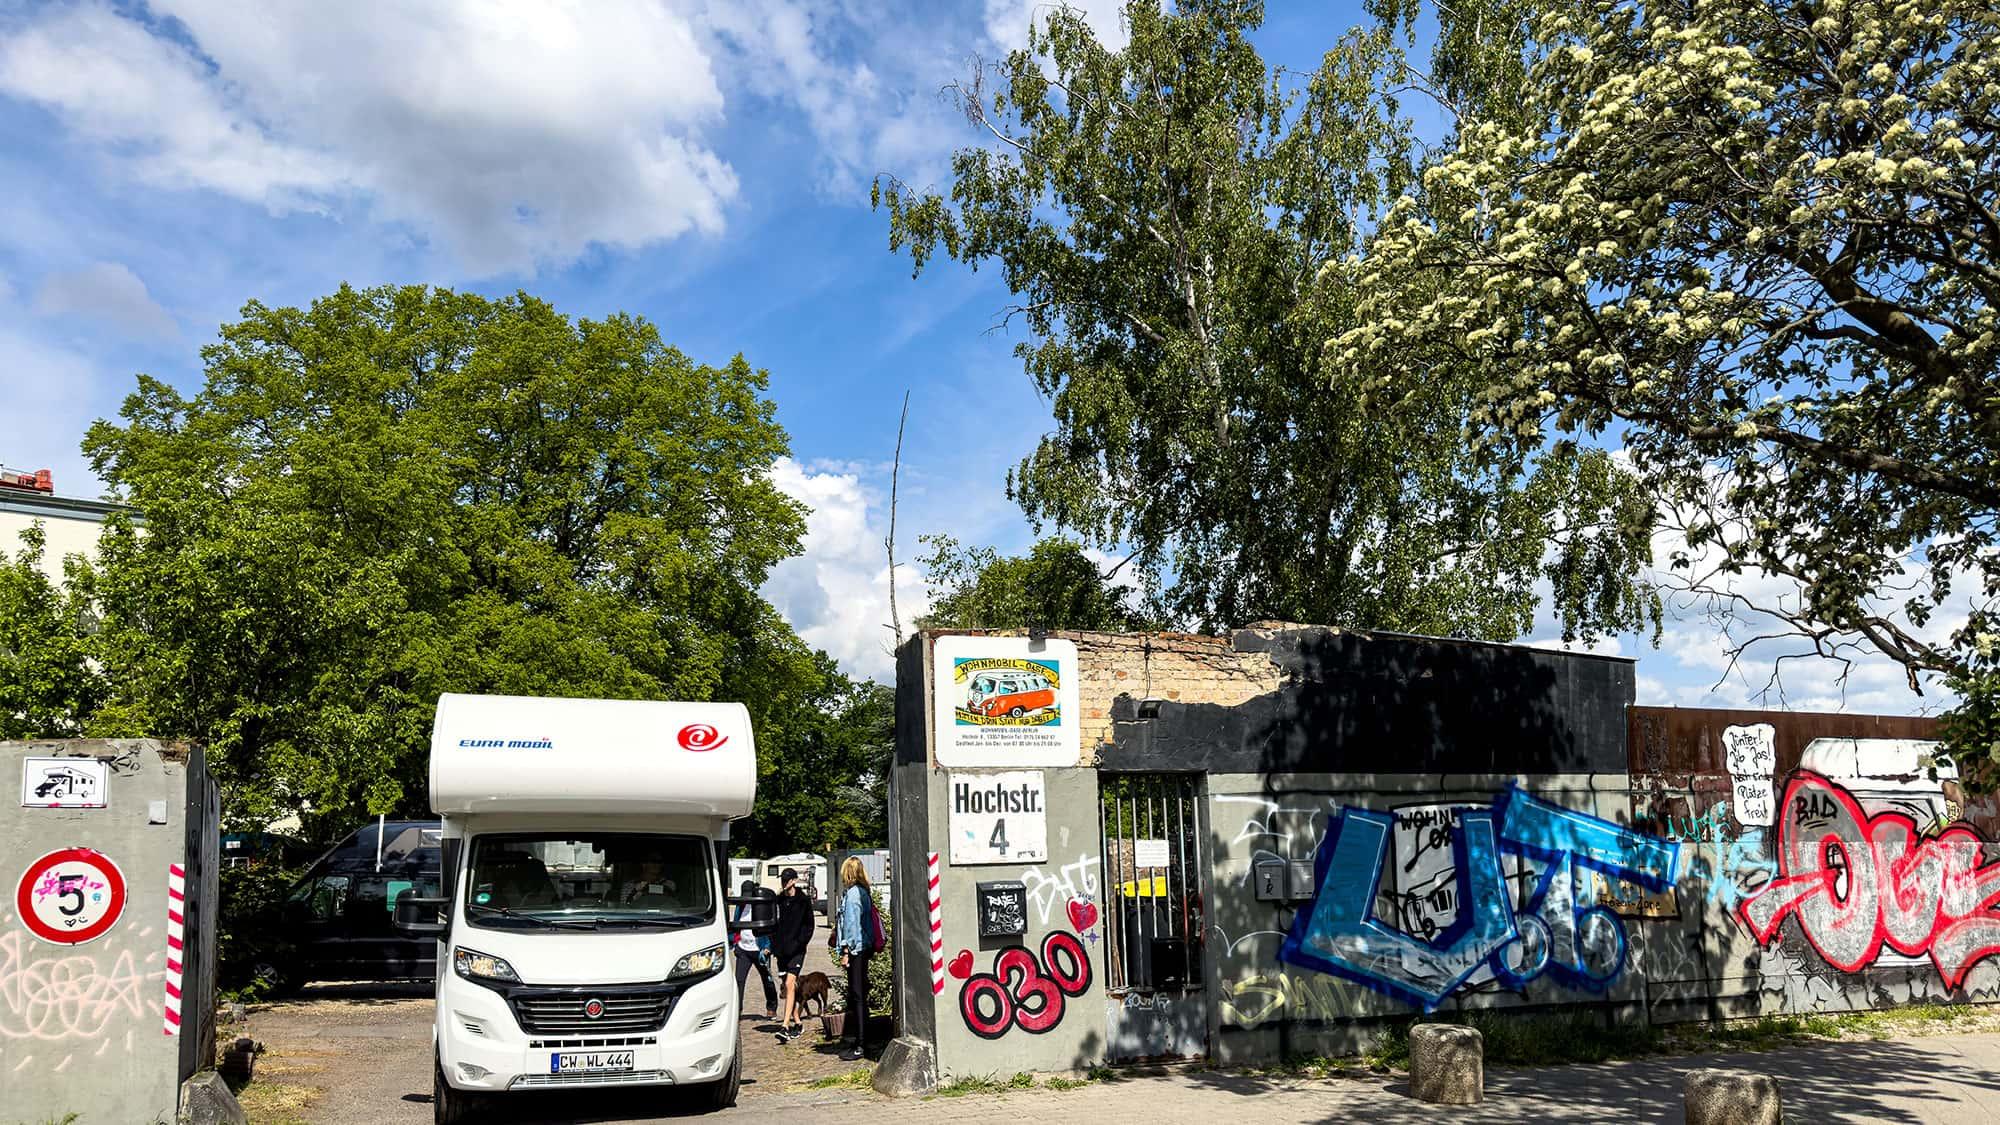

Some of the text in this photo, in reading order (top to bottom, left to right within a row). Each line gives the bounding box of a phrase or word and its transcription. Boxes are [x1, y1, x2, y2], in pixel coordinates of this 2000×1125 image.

[960, 658, 1018, 673] WOHNMOBIL
[459, 737, 553, 750] EURA MOBIL
[955, 783, 1042, 814] Hochstr.
[1794, 795, 1837, 824] BAD
[989, 818, 1010, 856] 4
[59, 874, 85, 916] 5
[959, 930, 1092, 1040] 030
[560, 1053, 632, 1069] CW WL 444
